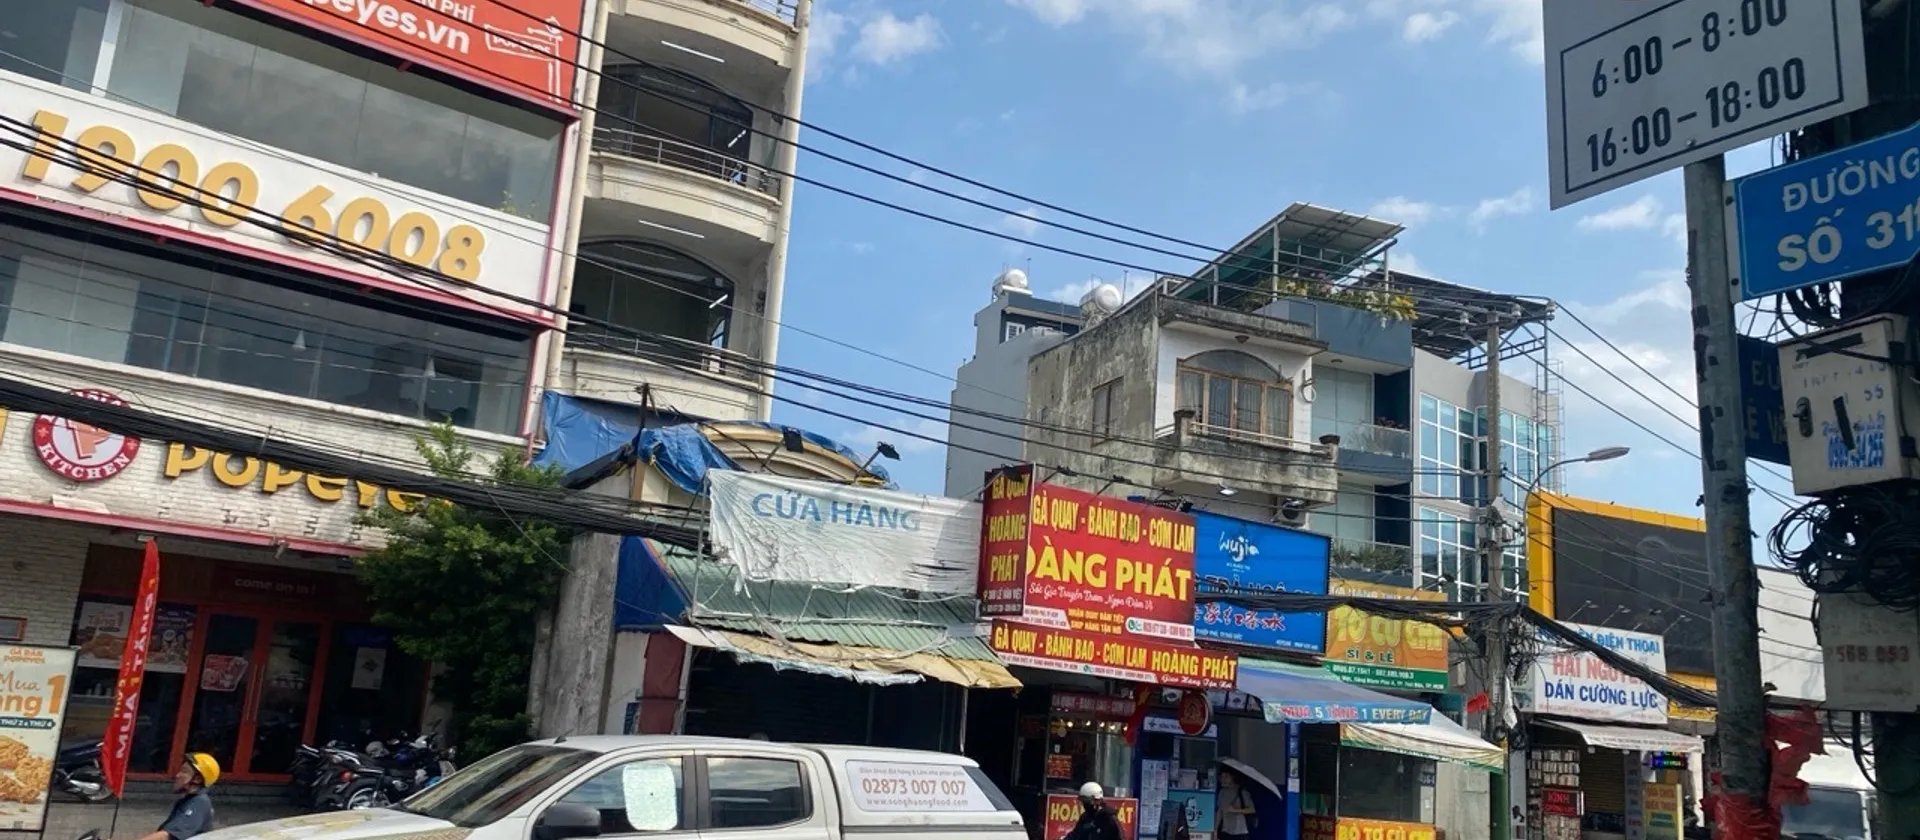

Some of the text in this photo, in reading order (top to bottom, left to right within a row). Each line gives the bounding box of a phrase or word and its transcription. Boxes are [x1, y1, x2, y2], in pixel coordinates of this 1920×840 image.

[1592, 36, 1663, 99] 6:00
[1701, 0, 1787, 52] 8:00
[1587, 107, 1672, 173] 16:00
[1706, 57, 1806, 129] 18:00
[22, 110, 485, 281] 1900 6008
[1782, 147, 1920, 213] ĐƯỜNG
[1777, 207, 1844, 272] SỐ
[40, 441, 131, 480] KITCHEN
[164, 441, 455, 514] POPEYE
[752, 489, 919, 532] CỬA HÀNG
[989, 510, 1026, 542] HOÀNG
[1033, 490, 1047, 526] GÀ
[1051, 498, 1079, 532] QUAY
[1088, 502, 1117, 539] BÁNH
[1119, 511, 1140, 543] BAO
[1149, 518, 1171, 549] CƠM
[1173, 524, 1195, 553] LAM
[990, 551, 1020, 582] PHÁT
[1116, 557, 1191, 600] PHÁT
[994, 623, 1009, 650] GÀ
[1012, 629, 1037, 653] QUAY
[1046, 631, 1073, 658] BÁNH
[1075, 639, 1095, 661] BAO
[1103, 642, 1125, 667] CƠM
[1126, 648, 1146, 668] LAM
[1152, 644, 1198, 676] HOÀNG
[1202, 654, 1237, 681] PHÁT
[1628, 636, 1660, 656] THOẠI
[0, 673, 67, 717] ng 1
[1281, 705, 1309, 719] MUA
[1315, 706, 1323, 718] 5
[1362, 708, 1367, 719] 1
[1372, 708, 1405, 720] EVERY
[1545, 679, 1574, 700] DÁN
[1580, 682, 1627, 706] CƯỜNG
[1631, 689, 1659, 710] LỰC
[862, 778, 966, 795] 02873 007 007
[1051, 800, 1086, 821] HOÀ
